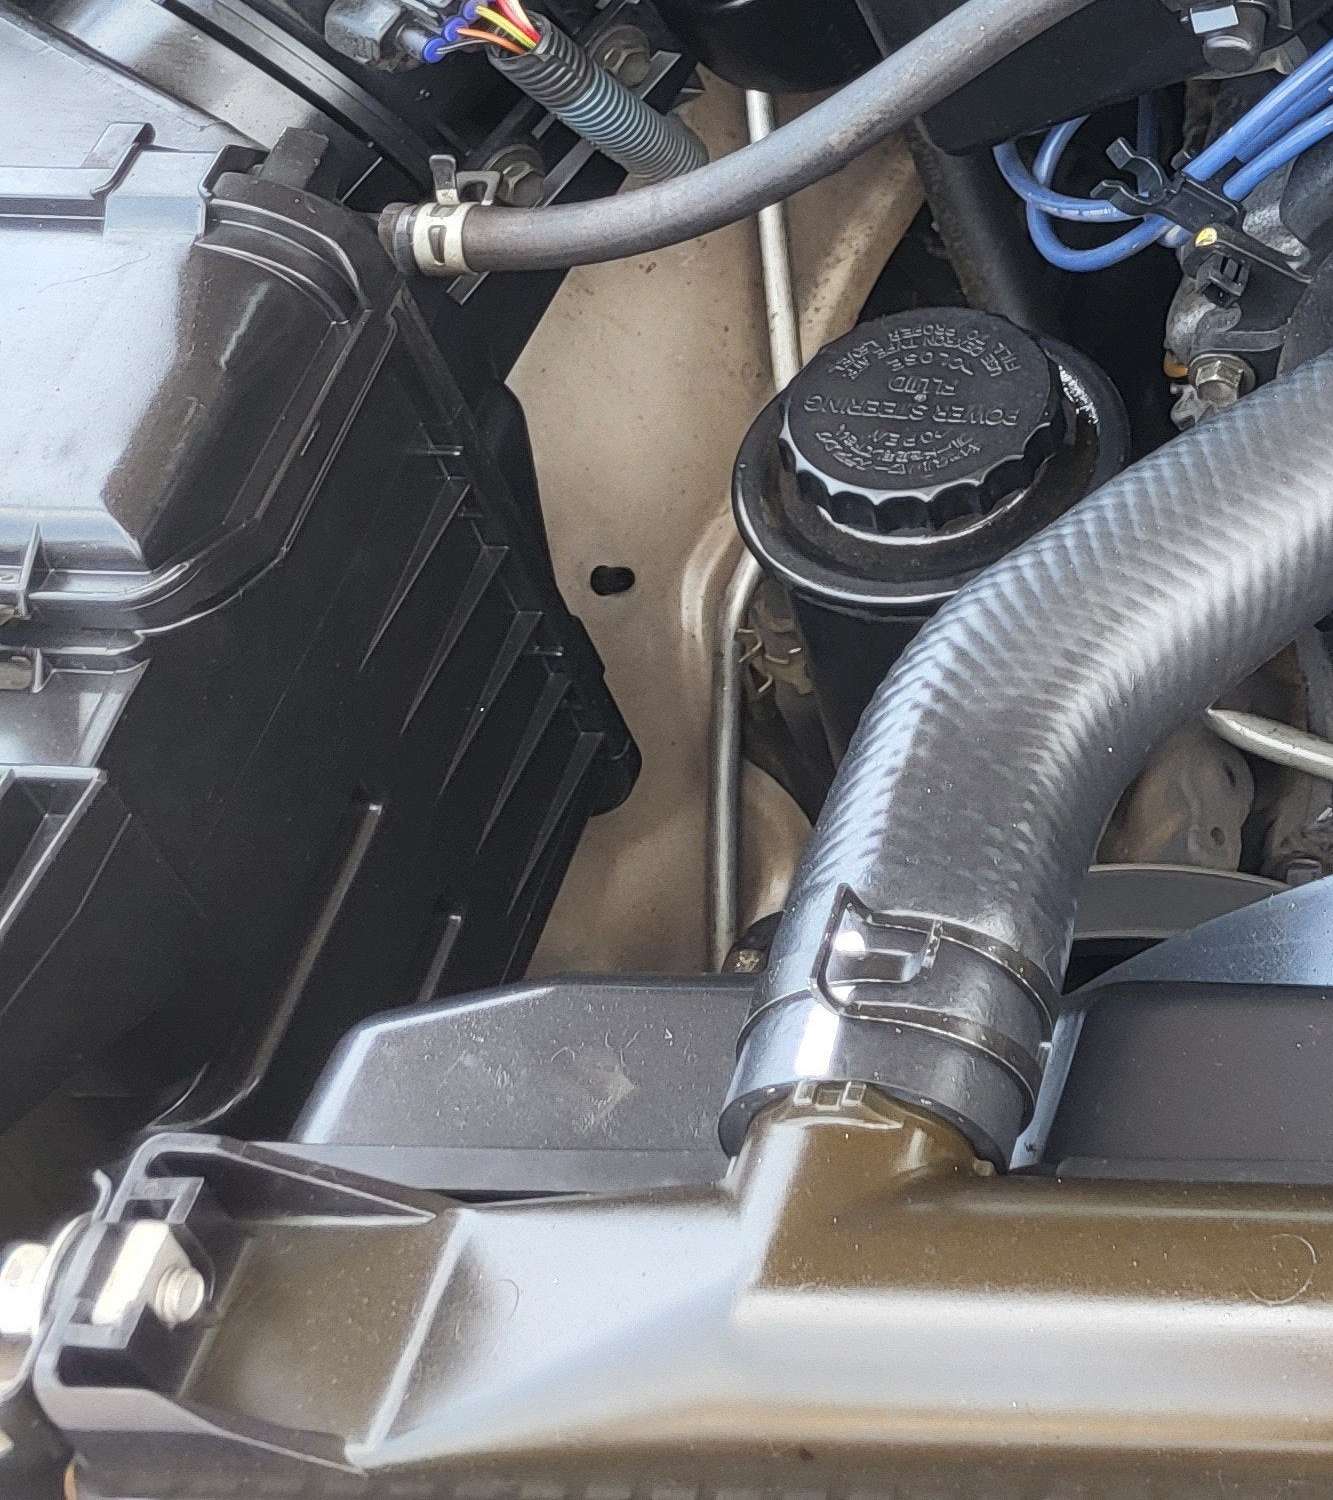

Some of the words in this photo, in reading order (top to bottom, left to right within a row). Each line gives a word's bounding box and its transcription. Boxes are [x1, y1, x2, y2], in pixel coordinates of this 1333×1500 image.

[887, 375, 958, 396] FLUID
[803, 394, 930, 421] STEERING
[931, 404, 1021, 426] POWER
